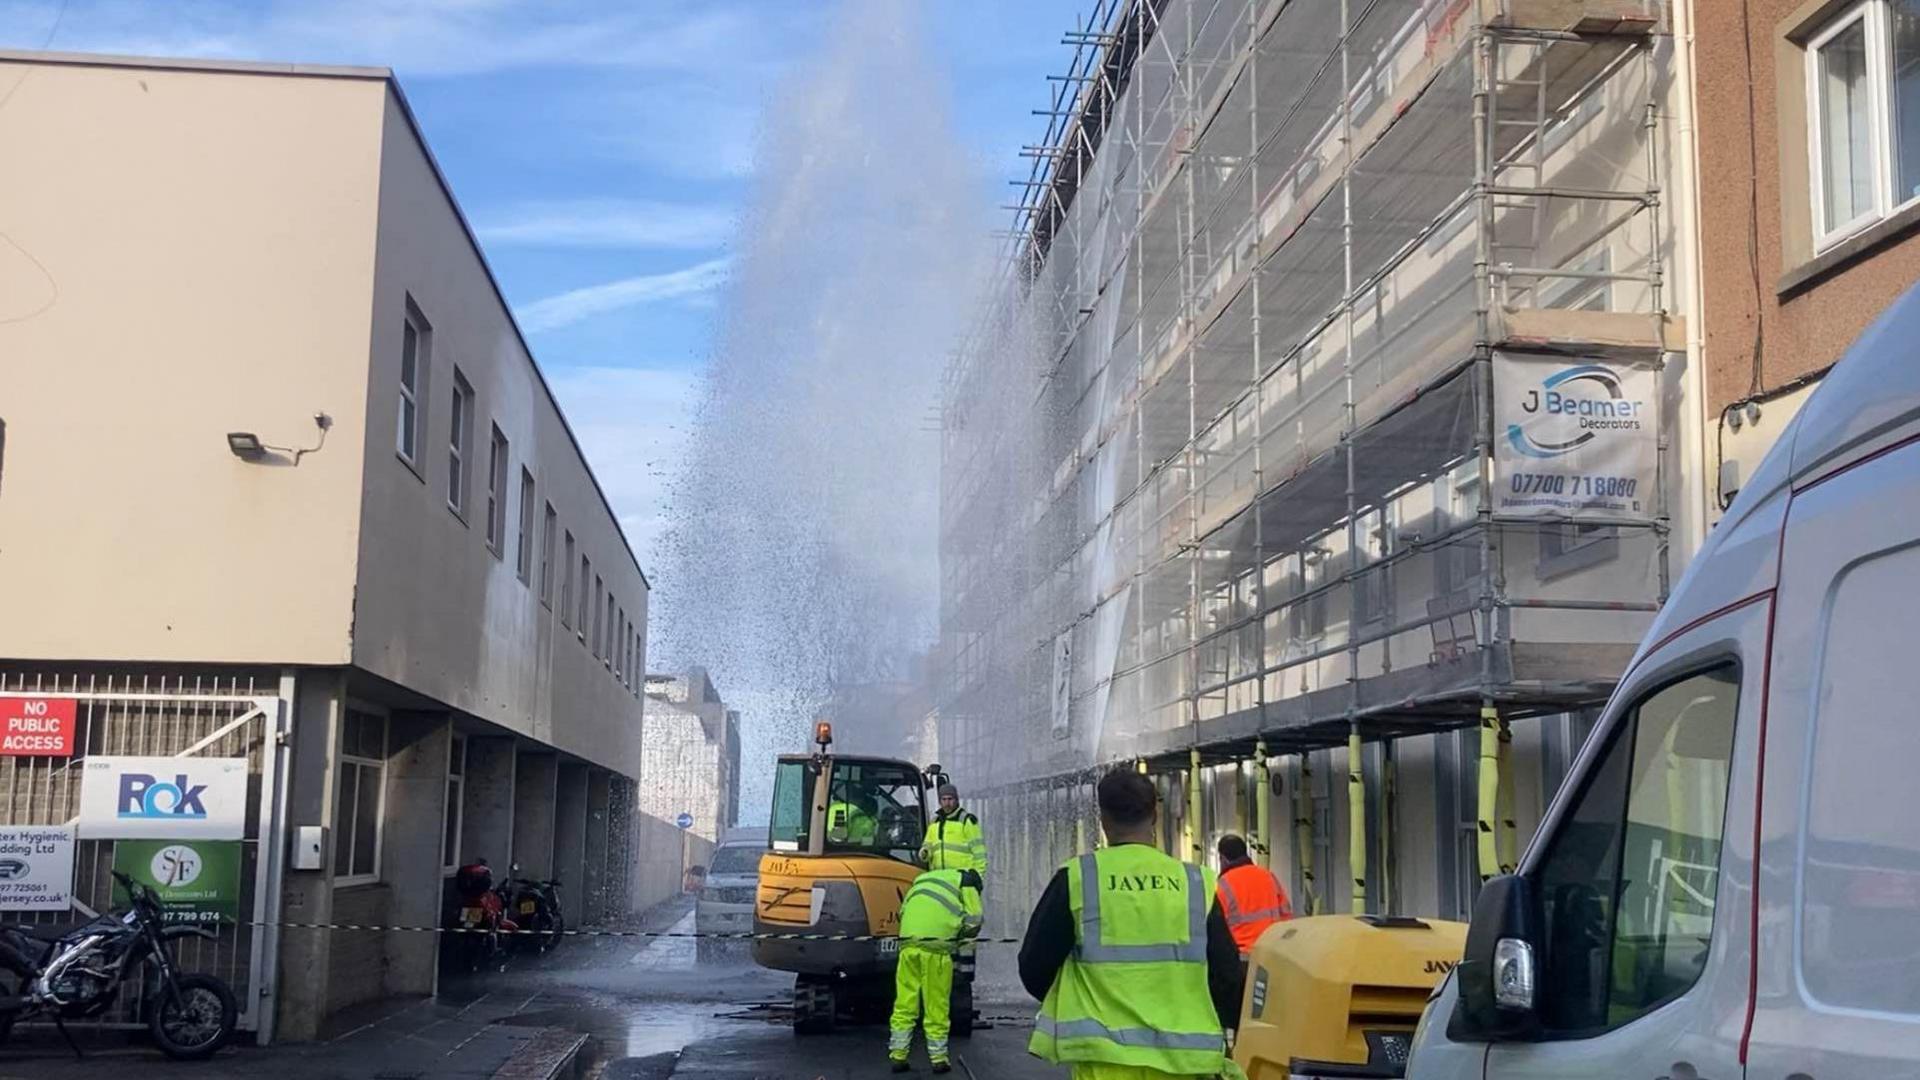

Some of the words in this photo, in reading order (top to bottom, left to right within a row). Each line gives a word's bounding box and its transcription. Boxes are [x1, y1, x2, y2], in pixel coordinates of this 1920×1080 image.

[1522, 390, 1539, 413] J
[1546, 392, 1642, 417] Beamer
[1579, 417, 1641, 430] Decorators
[1512, 473, 1565, 494] 07700
[24, 701, 48, 715] NO
[8, 717, 61, 732] PUBLIC
[2, 735, 65, 750] ACCESS
[20, 831, 69, 844] Hygienic
[36, 843, 55, 854] Ltd
[1108, 875, 1181, 892] JAYEN
[177, 911, 198, 921] 799
[199, 911, 220, 921] 674
